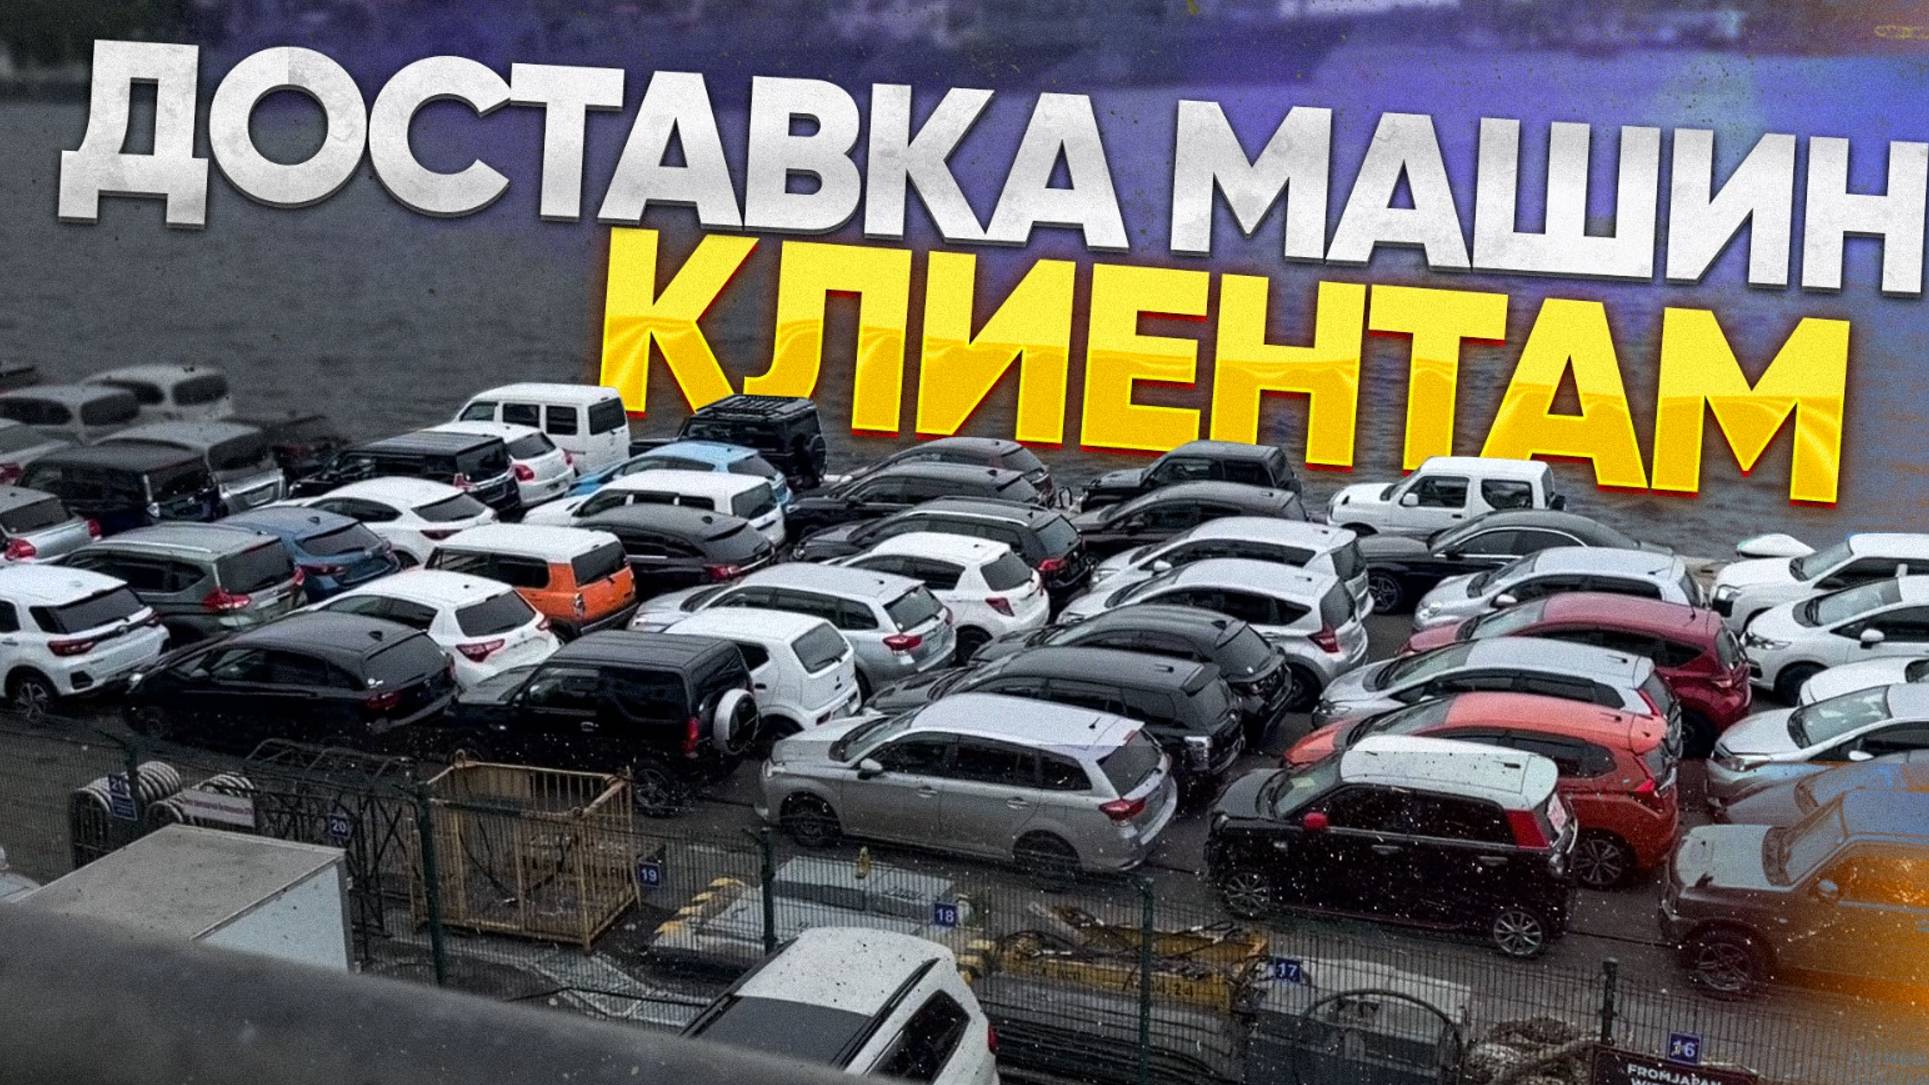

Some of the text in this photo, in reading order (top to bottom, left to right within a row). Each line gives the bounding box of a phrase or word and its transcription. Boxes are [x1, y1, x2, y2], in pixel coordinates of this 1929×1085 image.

[331, 819, 347, 833] 20
[641, 868, 658, 881] 19
[936, 908, 954, 923] 18
[1278, 962, 1298, 977] 17
[1672, 1039, 1696, 1057] 16
